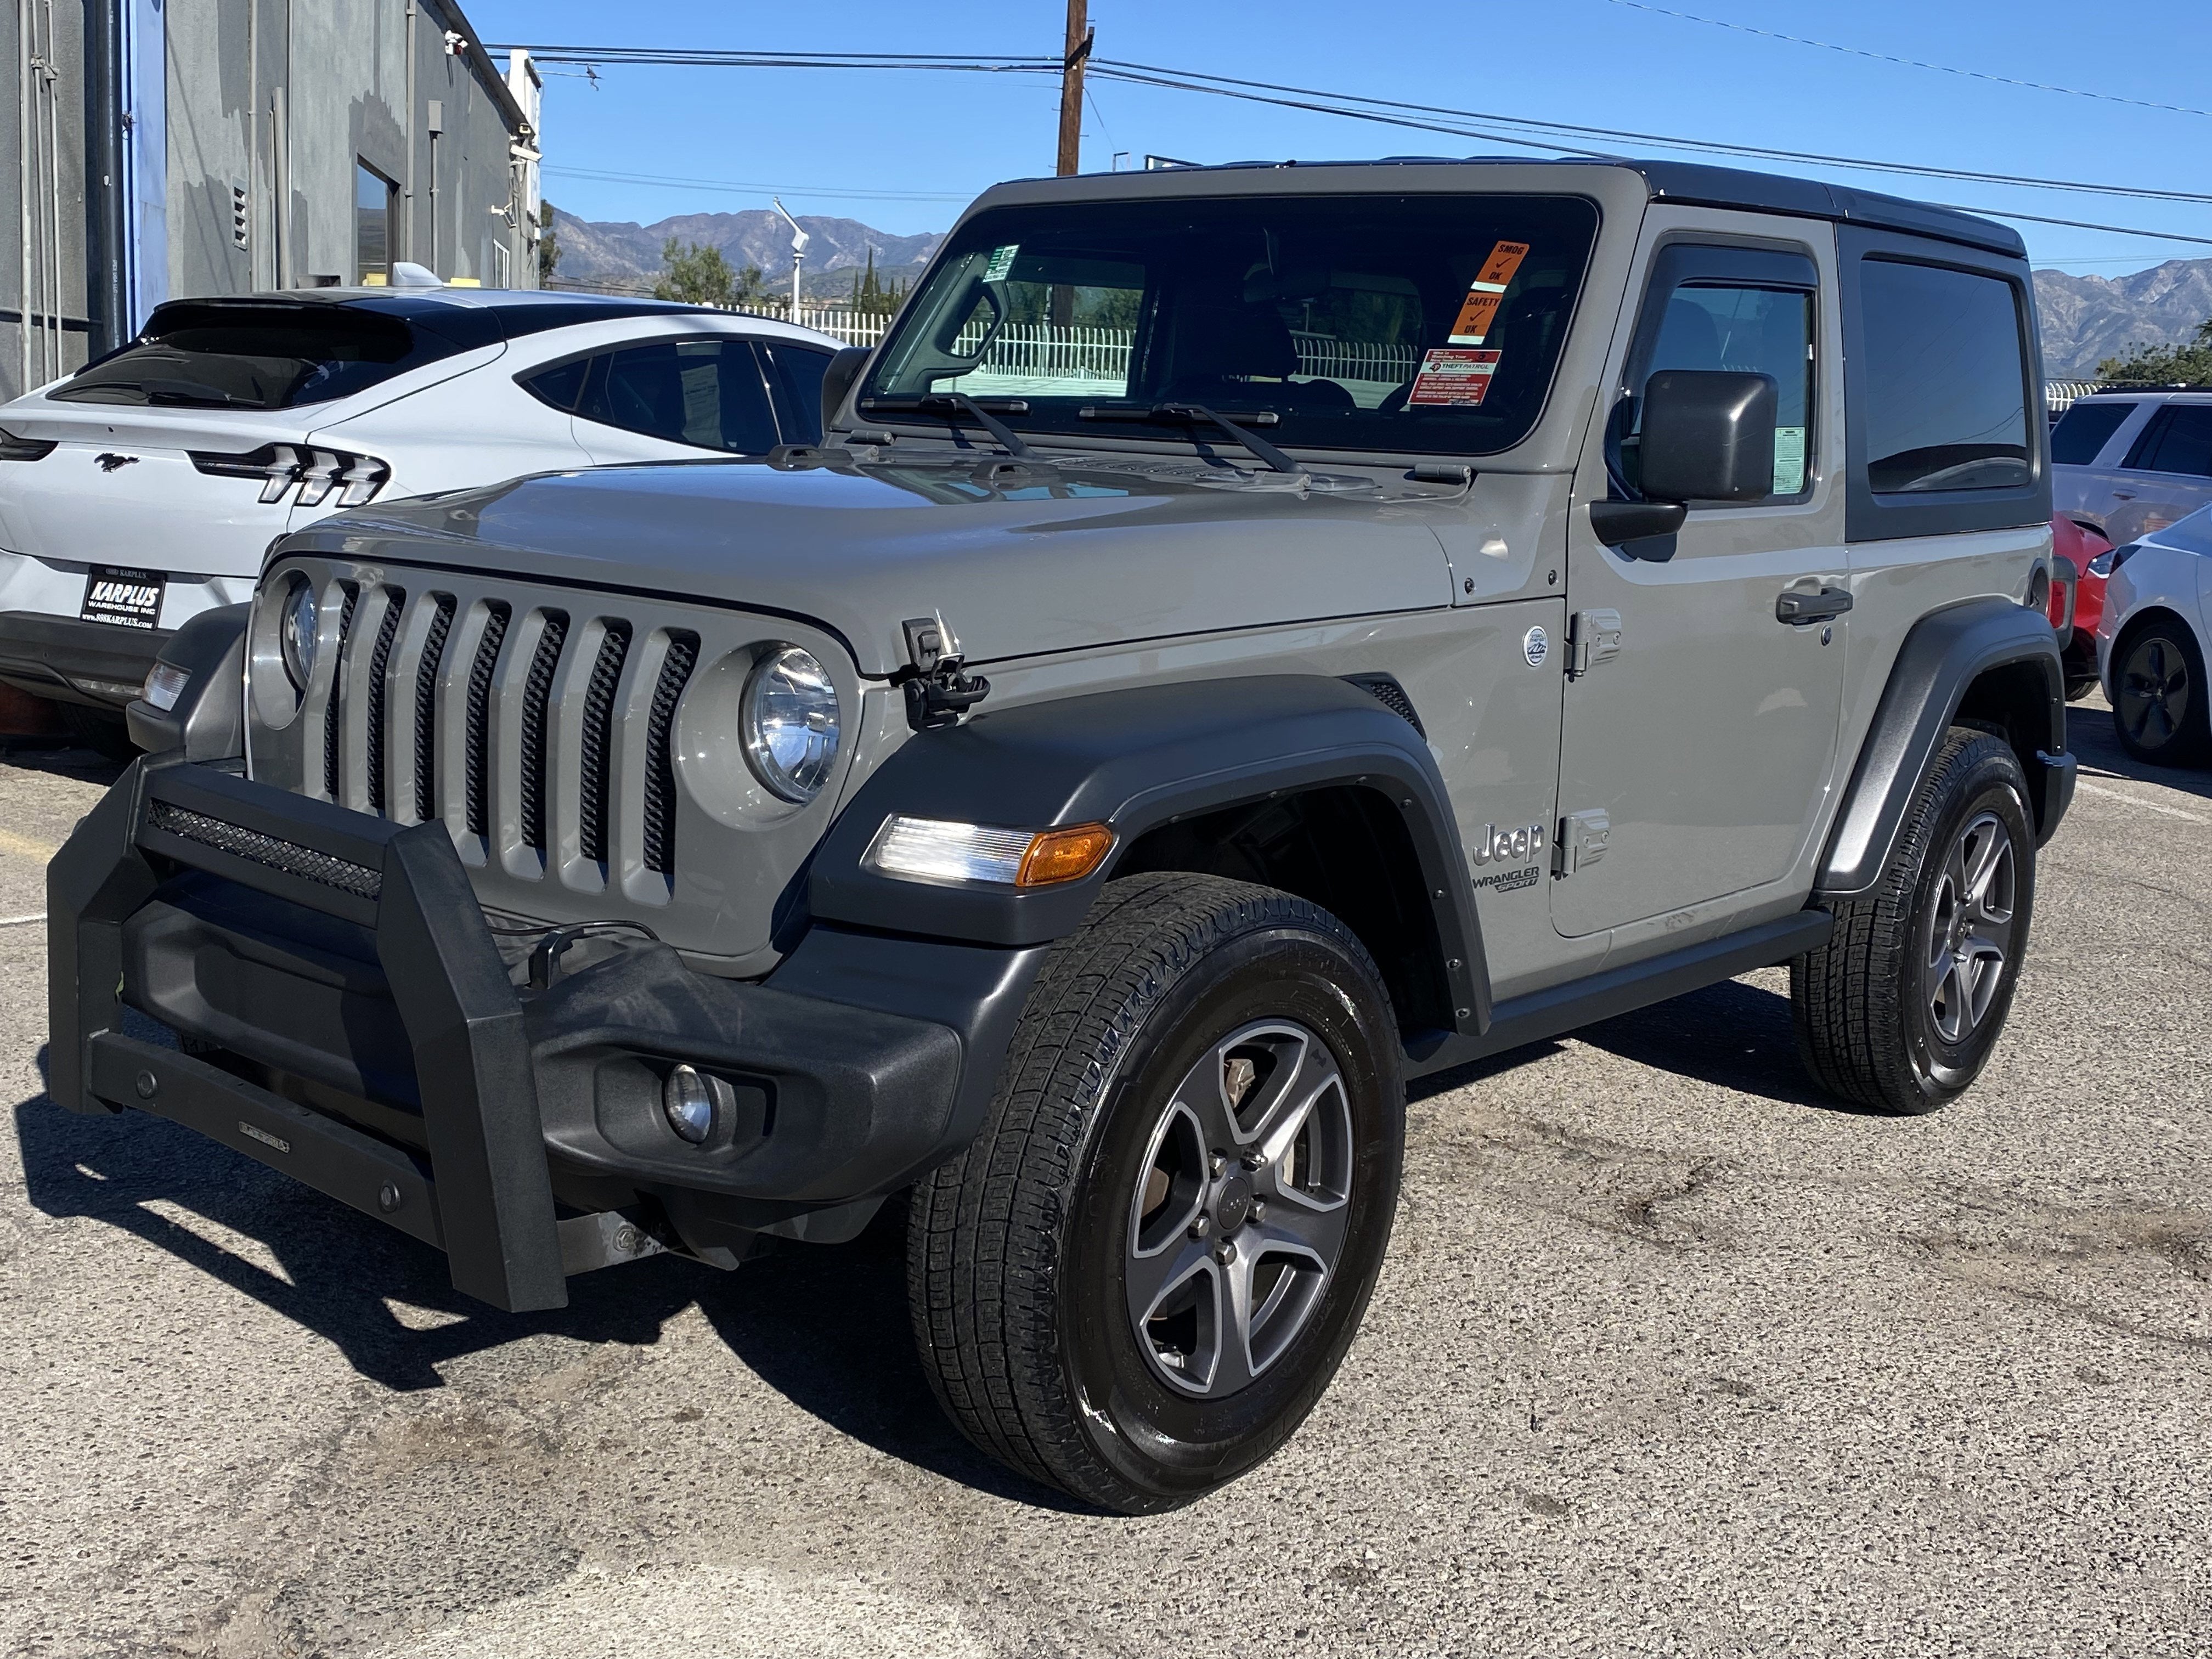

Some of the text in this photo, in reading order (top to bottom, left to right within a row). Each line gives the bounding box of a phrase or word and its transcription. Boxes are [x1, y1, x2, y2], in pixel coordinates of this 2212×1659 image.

[1498, 244, 1525, 255] SMOG
[1489, 272, 1503, 280] OK
[1466, 297, 1500, 307] SAFETY
[1464, 325, 1478, 334] OK
[120, 569, 146, 579] KARPLUS
[89, 582, 159, 607] KARPLUS
[88, 600, 139, 612] WAREHOUSE
[1473, 823, 1544, 866] Jeep
[1472, 866, 1539, 889] WRANGLER
[1497, 878, 1537, 891] SPORT
